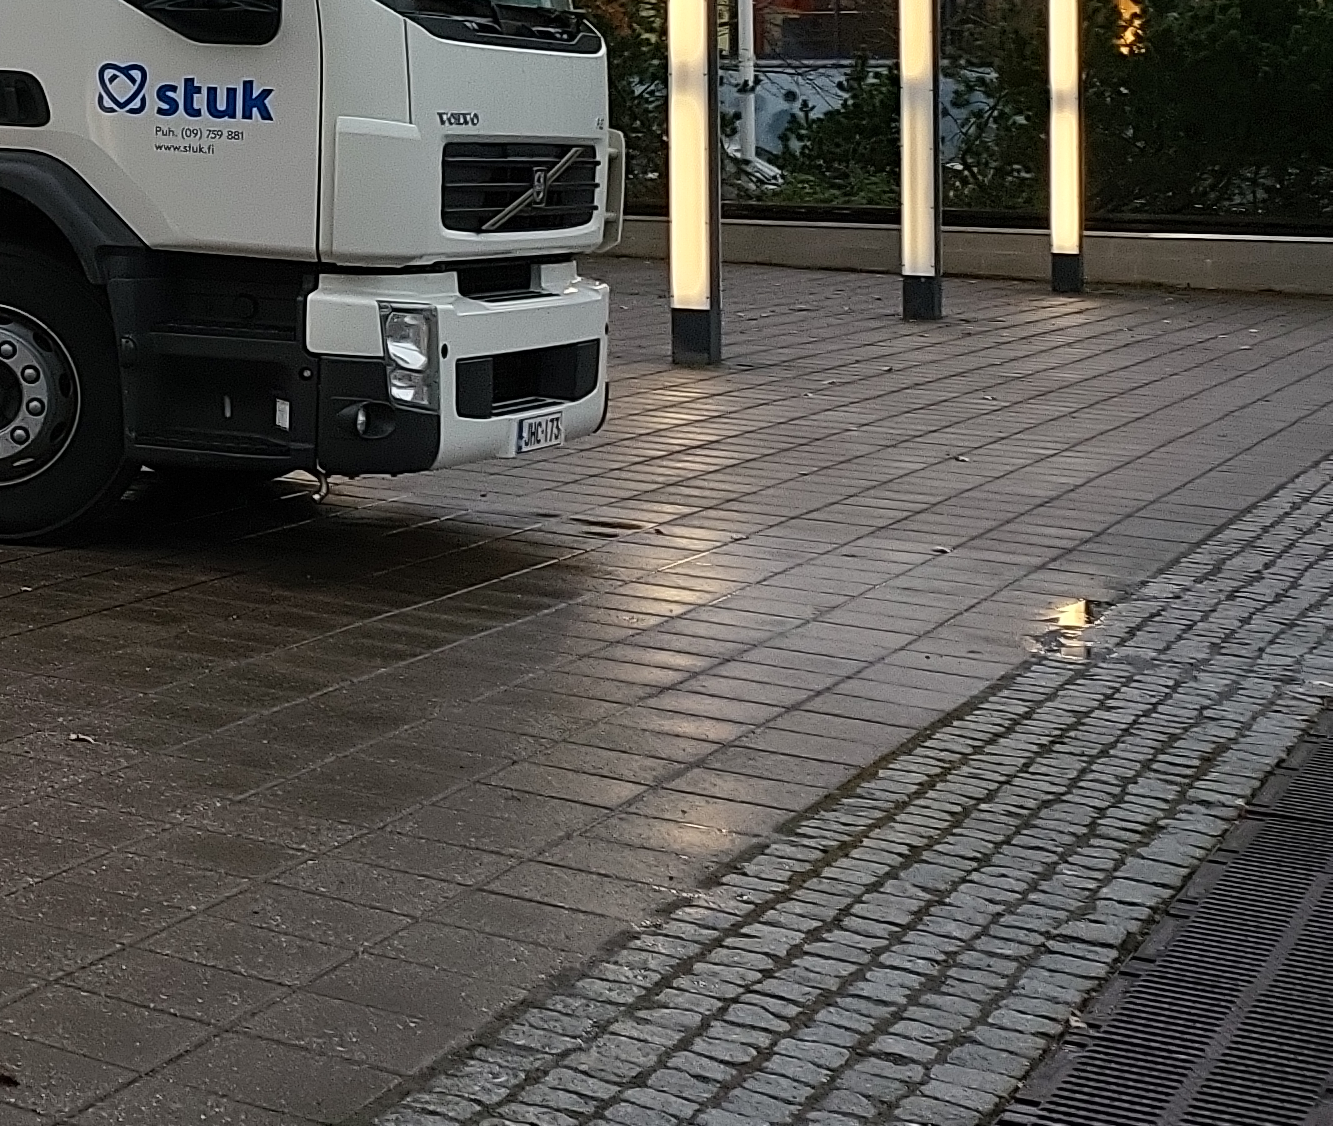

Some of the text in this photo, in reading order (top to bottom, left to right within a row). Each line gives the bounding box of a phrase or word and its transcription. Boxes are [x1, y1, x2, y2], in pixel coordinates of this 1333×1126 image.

[155, 77, 275, 122] stuk
[436, 111, 480, 127] VOLVO
[154, 126, 245, 141] Puh. (09) 759 881
[154, 143, 215, 155] www.stuk.fi
